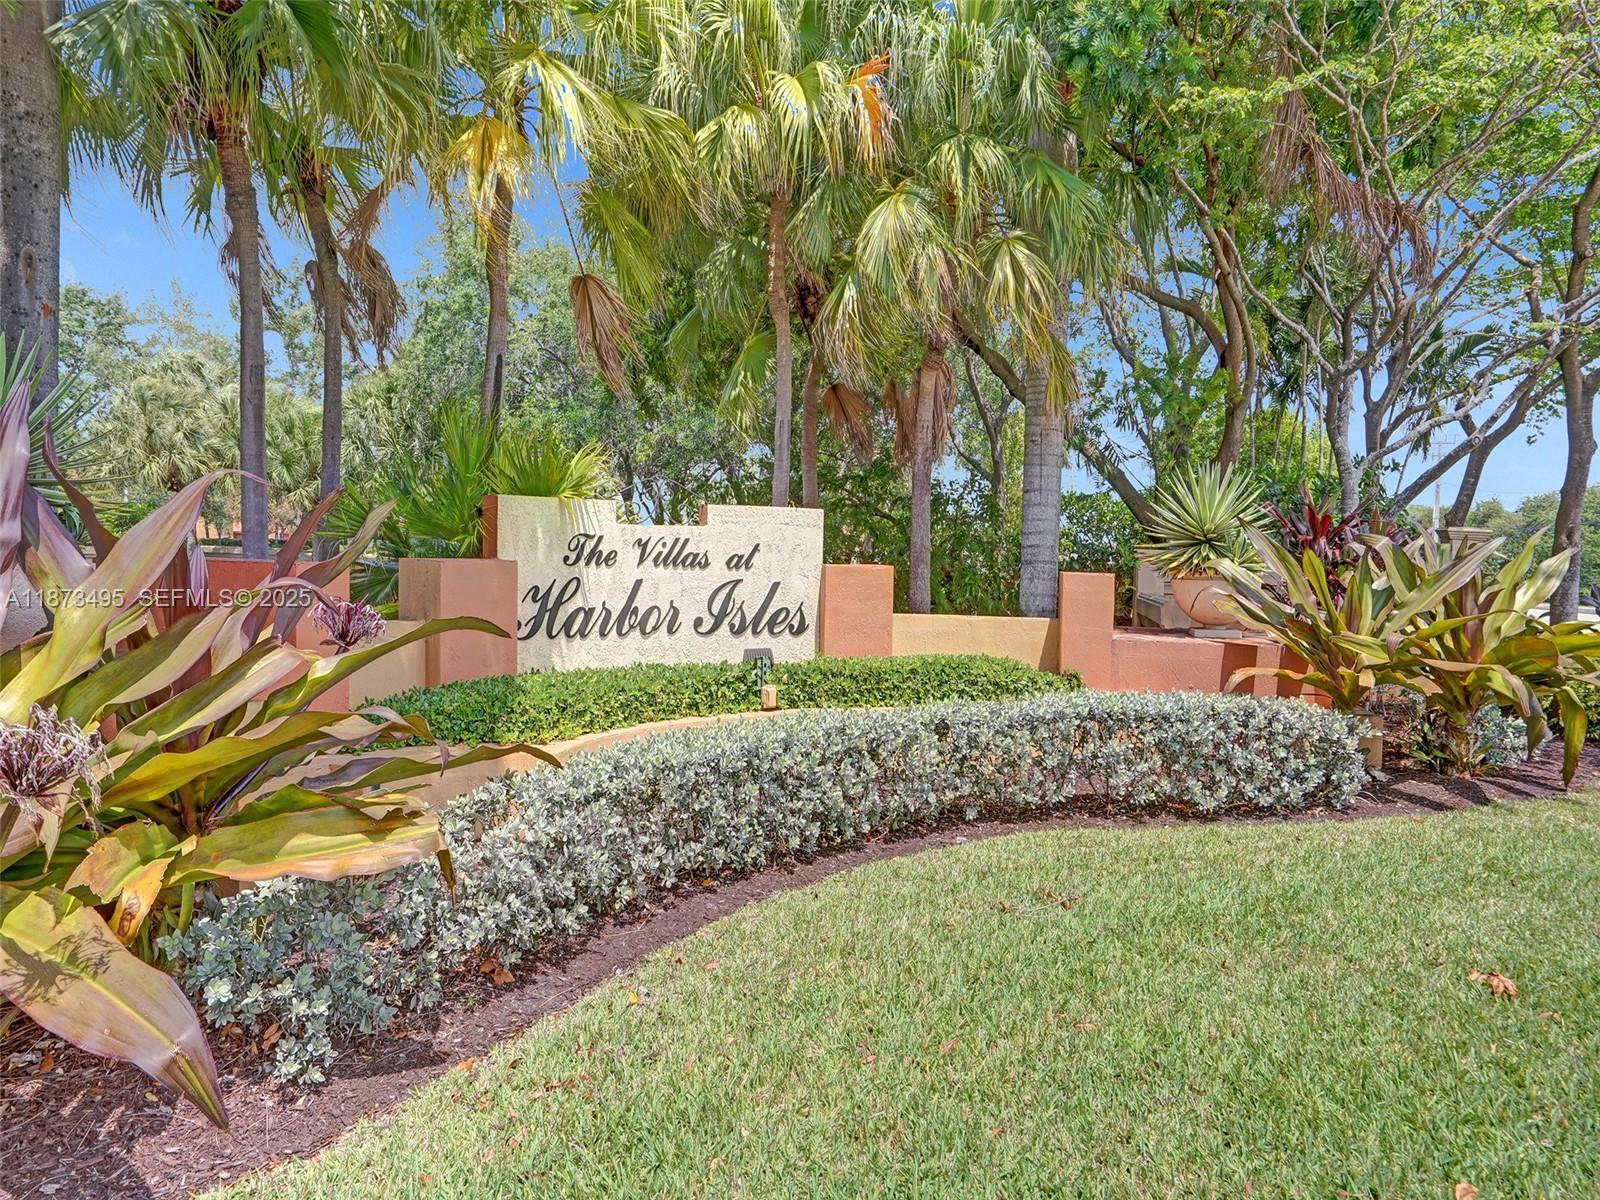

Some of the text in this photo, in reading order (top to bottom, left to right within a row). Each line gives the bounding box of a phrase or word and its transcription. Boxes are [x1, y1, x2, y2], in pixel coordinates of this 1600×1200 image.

[563, 533, 760, 570] The Villas at
[517, 576, 810, 640] Harbor Isles
